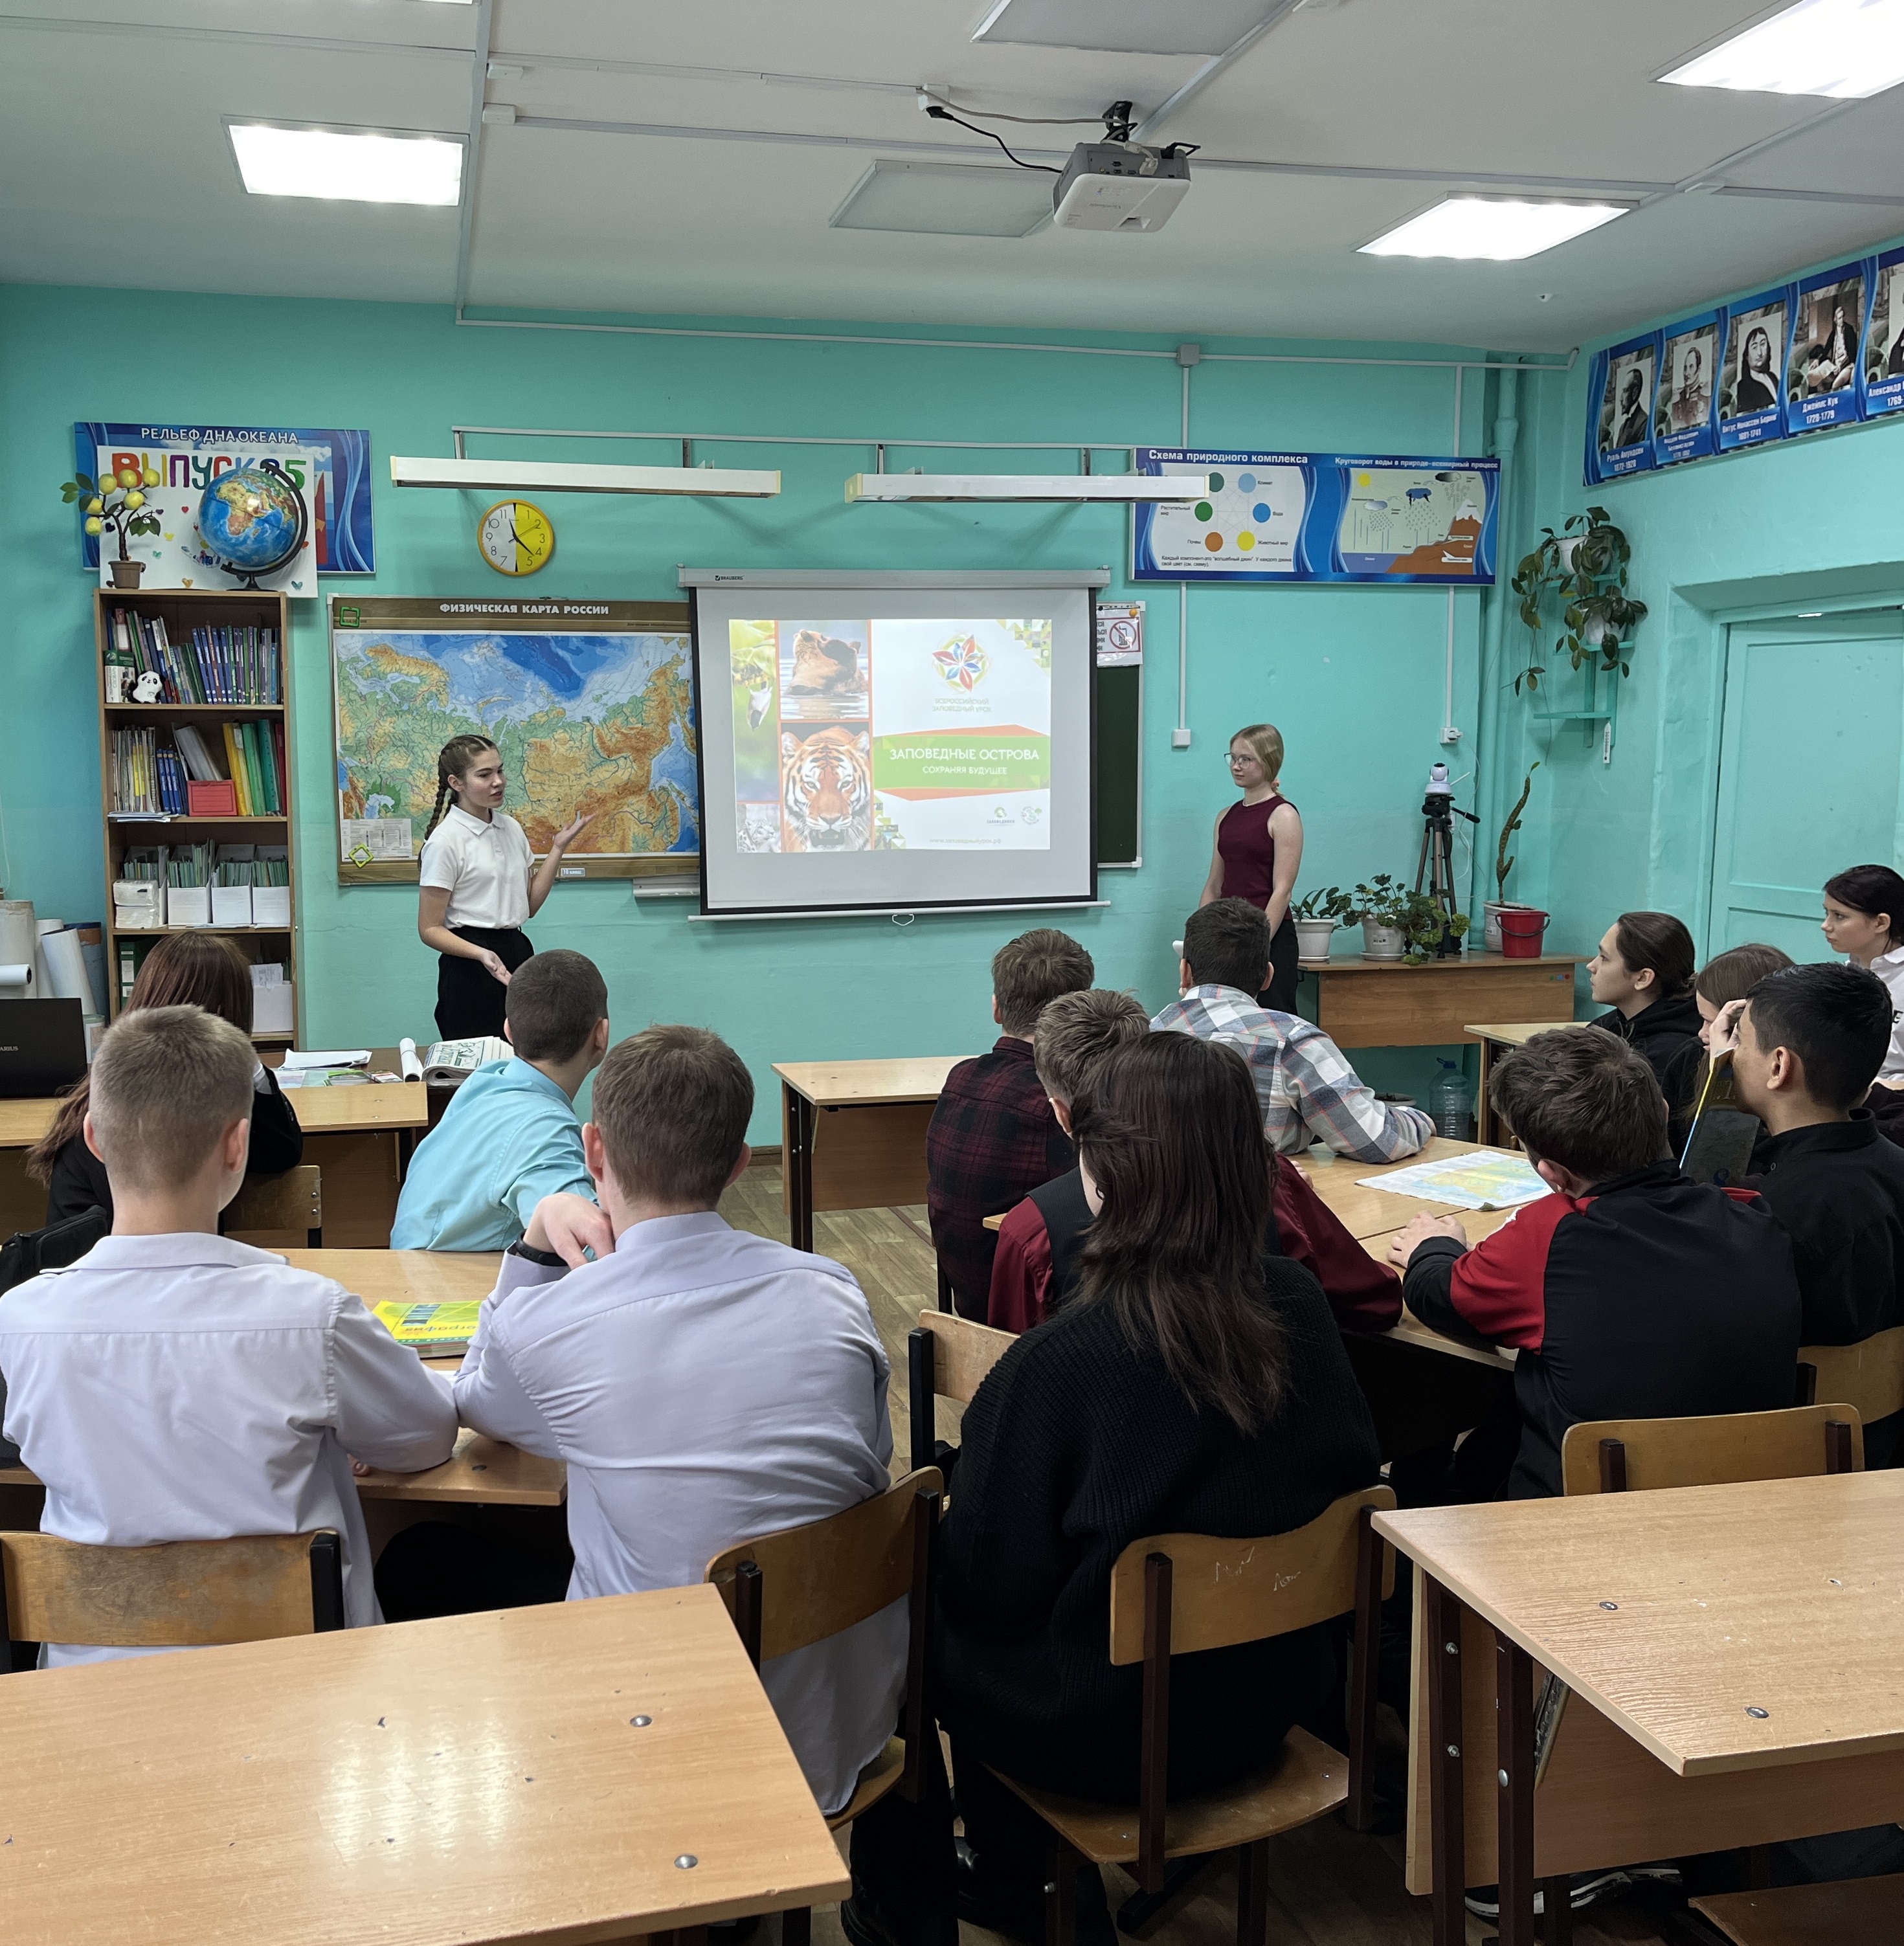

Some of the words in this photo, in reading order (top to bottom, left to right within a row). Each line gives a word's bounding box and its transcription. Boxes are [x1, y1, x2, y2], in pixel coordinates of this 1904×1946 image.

[1827, 397, 1839, 407] Кук
[141, 428, 200, 441] РЕЛЬЕФ
[203, 430, 235, 444] ДНА
[238, 431, 298, 443] ОКЕАНА
[1148, 449, 1183, 460] Схема
[1187, 453, 1248, 463] природного
[1251, 454, 1308, 464] комплекса
[1335, 457, 1373, 465] Круговорот
[500, 509, 506, 519] 11
[487, 519, 499, 528] 10
[535, 519, 541, 529] 2
[486, 532, 493, 541] 9
[539, 533, 545, 543] 3
[491, 546, 497, 555] 8
[535, 547, 542, 556] 4
[500, 556, 507, 566] 7
[526, 556, 533, 566] 5
[440, 603, 517, 613] ФИЗИЧЕСКАЯ
[522, 605, 559, 614] КАРТА
[564, 605, 609, 614] РОССИИ
[890, 748, 976, 761] ЗАПОВЕДНЫЕ
[979, 749, 1040, 760] ОСТРОВА
[969, 766, 1007, 775] БУДУЩЕЕ
